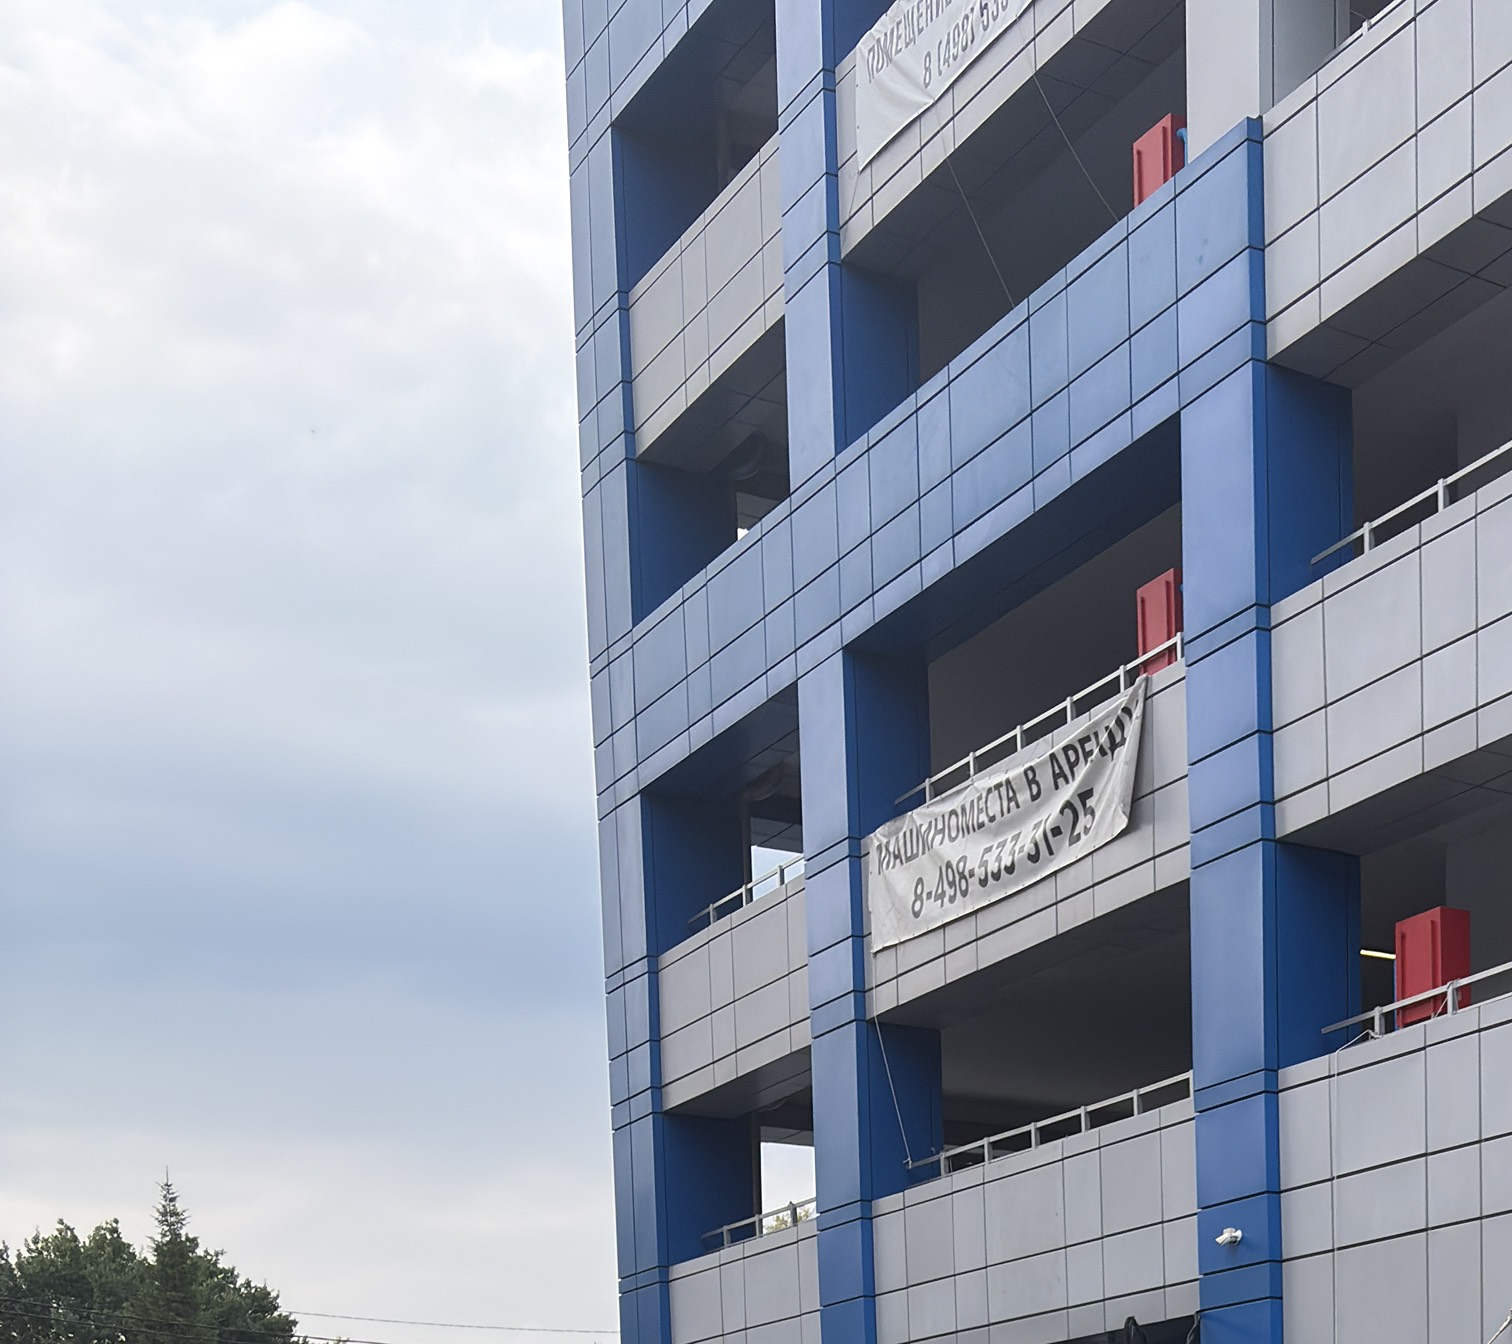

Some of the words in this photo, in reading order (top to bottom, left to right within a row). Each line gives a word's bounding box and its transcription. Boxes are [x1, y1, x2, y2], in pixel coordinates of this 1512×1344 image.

[923, 51, 932, 89] 8
[876, 777, 1020, 876] МАШИНОМЕСТА
[1023, 765, 1042, 802] В
[911, 787, 1096, 919] 8-498-533-31-25
